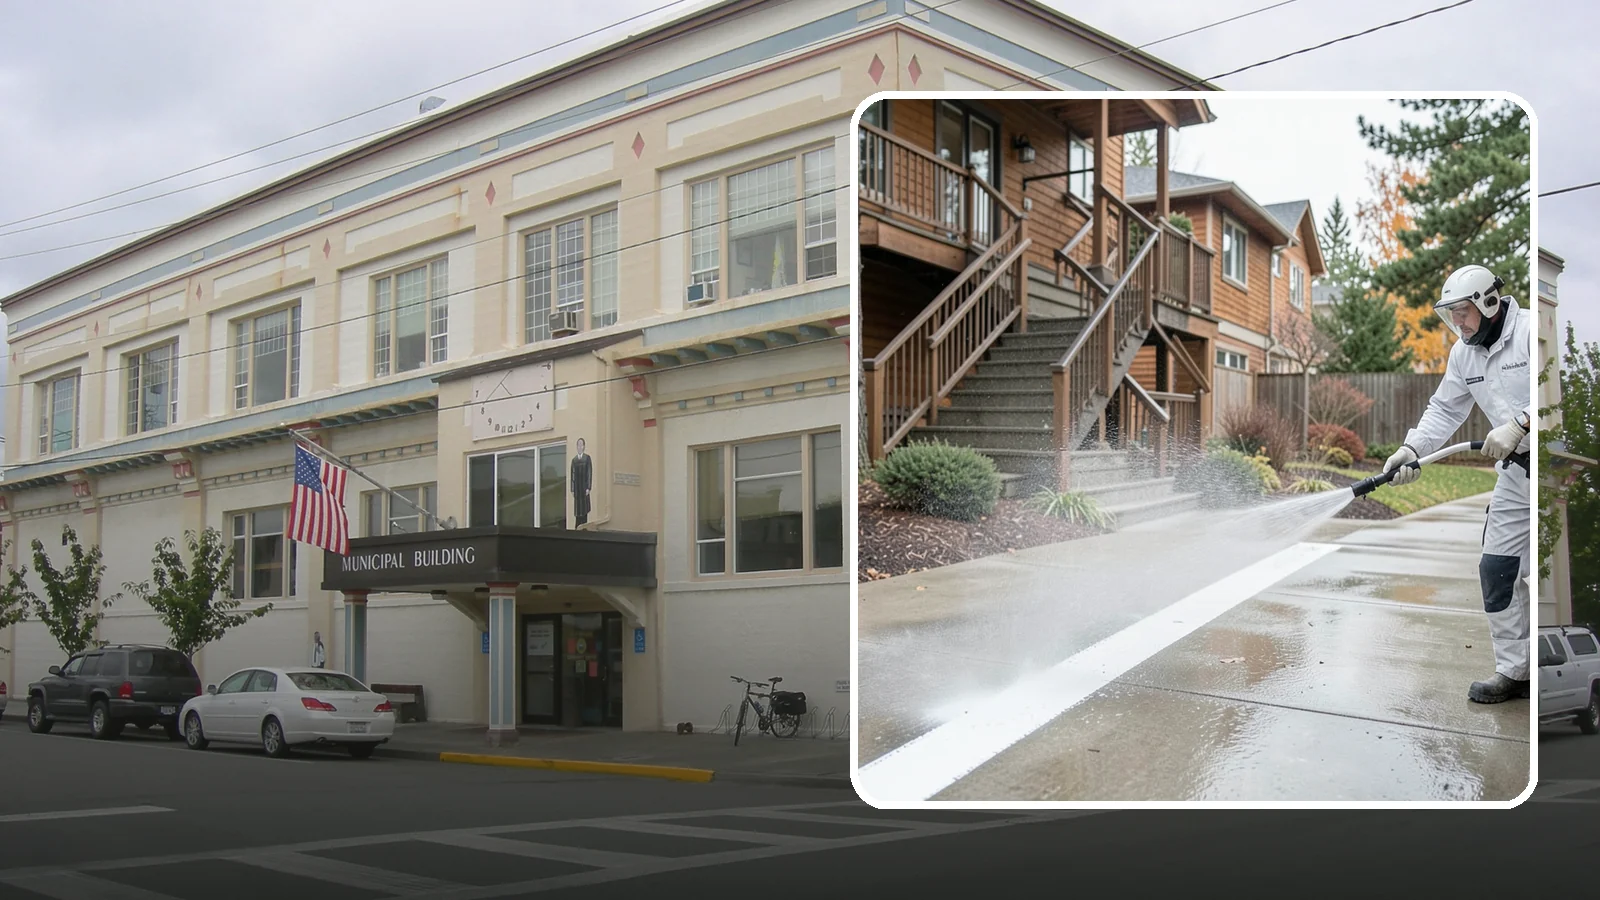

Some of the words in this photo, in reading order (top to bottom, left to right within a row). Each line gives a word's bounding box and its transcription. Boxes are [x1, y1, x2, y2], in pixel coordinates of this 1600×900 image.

[546, 361, 552, 370] 6
[475, 390, 479, 398] 7
[536, 402, 540, 410] 4
[480, 407, 485, 415] 8
[487, 417, 492, 426] 9
[528, 414, 533, 422] 3
[494, 423, 500, 432] 10
[521, 420, 526, 428] 2
[501, 425, 506, 433] 11
[507, 425, 513, 433] 12
[342, 552, 405, 572] MUNICIPAL
[414, 546, 475, 567] BUILDING
